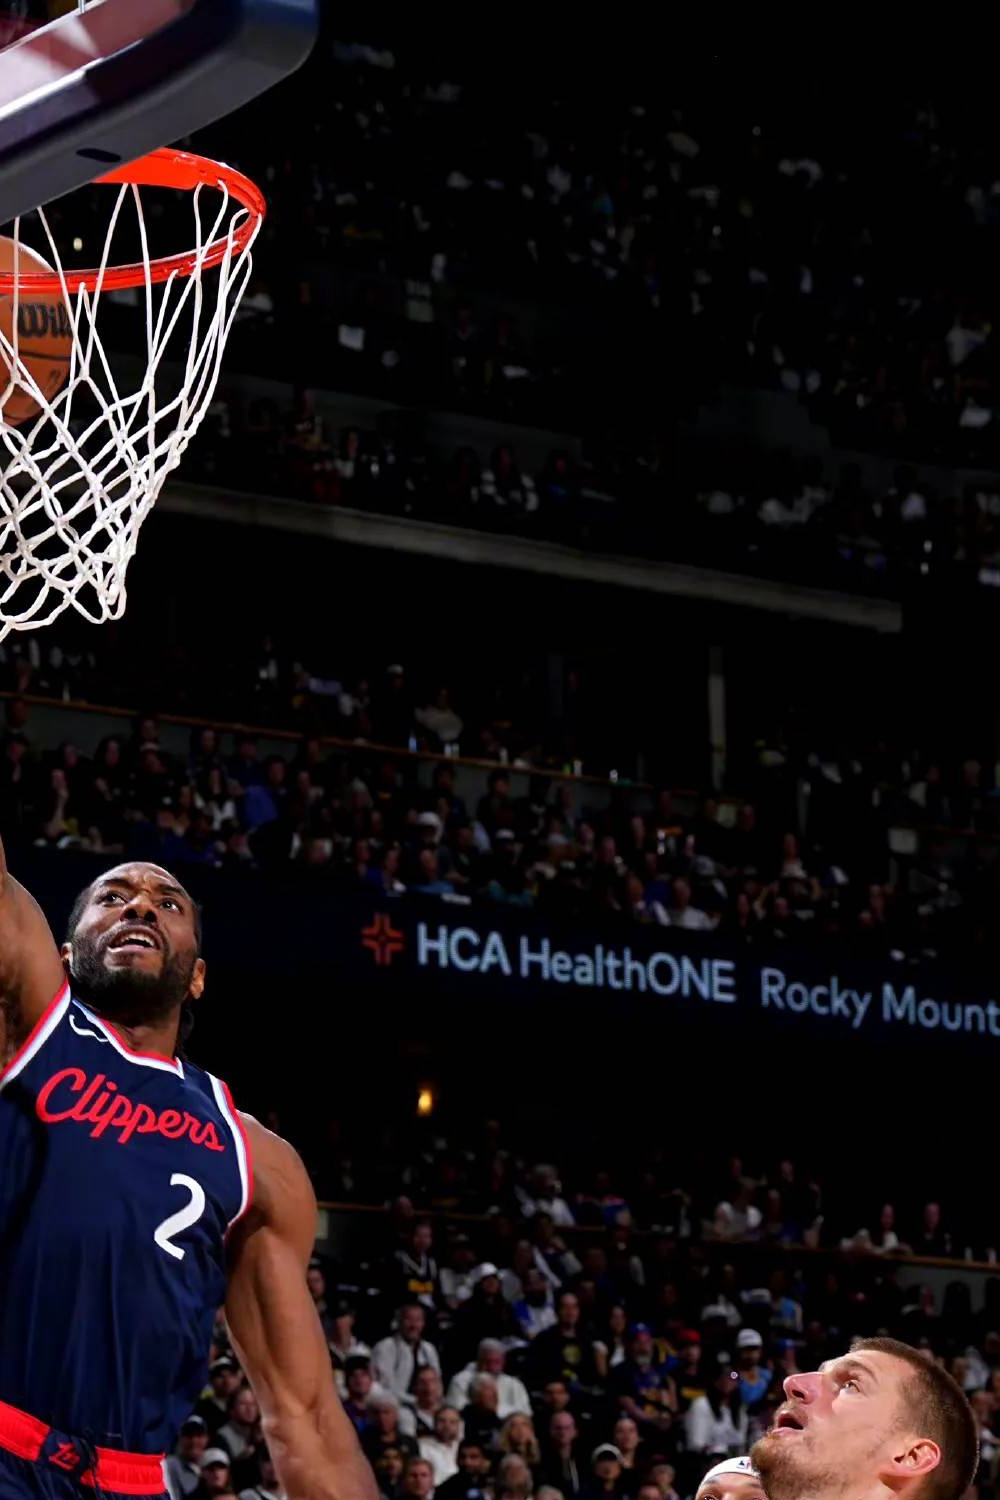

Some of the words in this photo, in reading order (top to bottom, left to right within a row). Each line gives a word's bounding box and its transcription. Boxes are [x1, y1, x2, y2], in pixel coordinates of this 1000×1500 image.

[417, 923, 511, 976] HCA
[520, 935, 737, 1003] HealthONE
[760, 967, 871, 1029] Rocky
[36, 1067, 226, 1152] Clippers
[154, 1173, 206, 1260] 2
